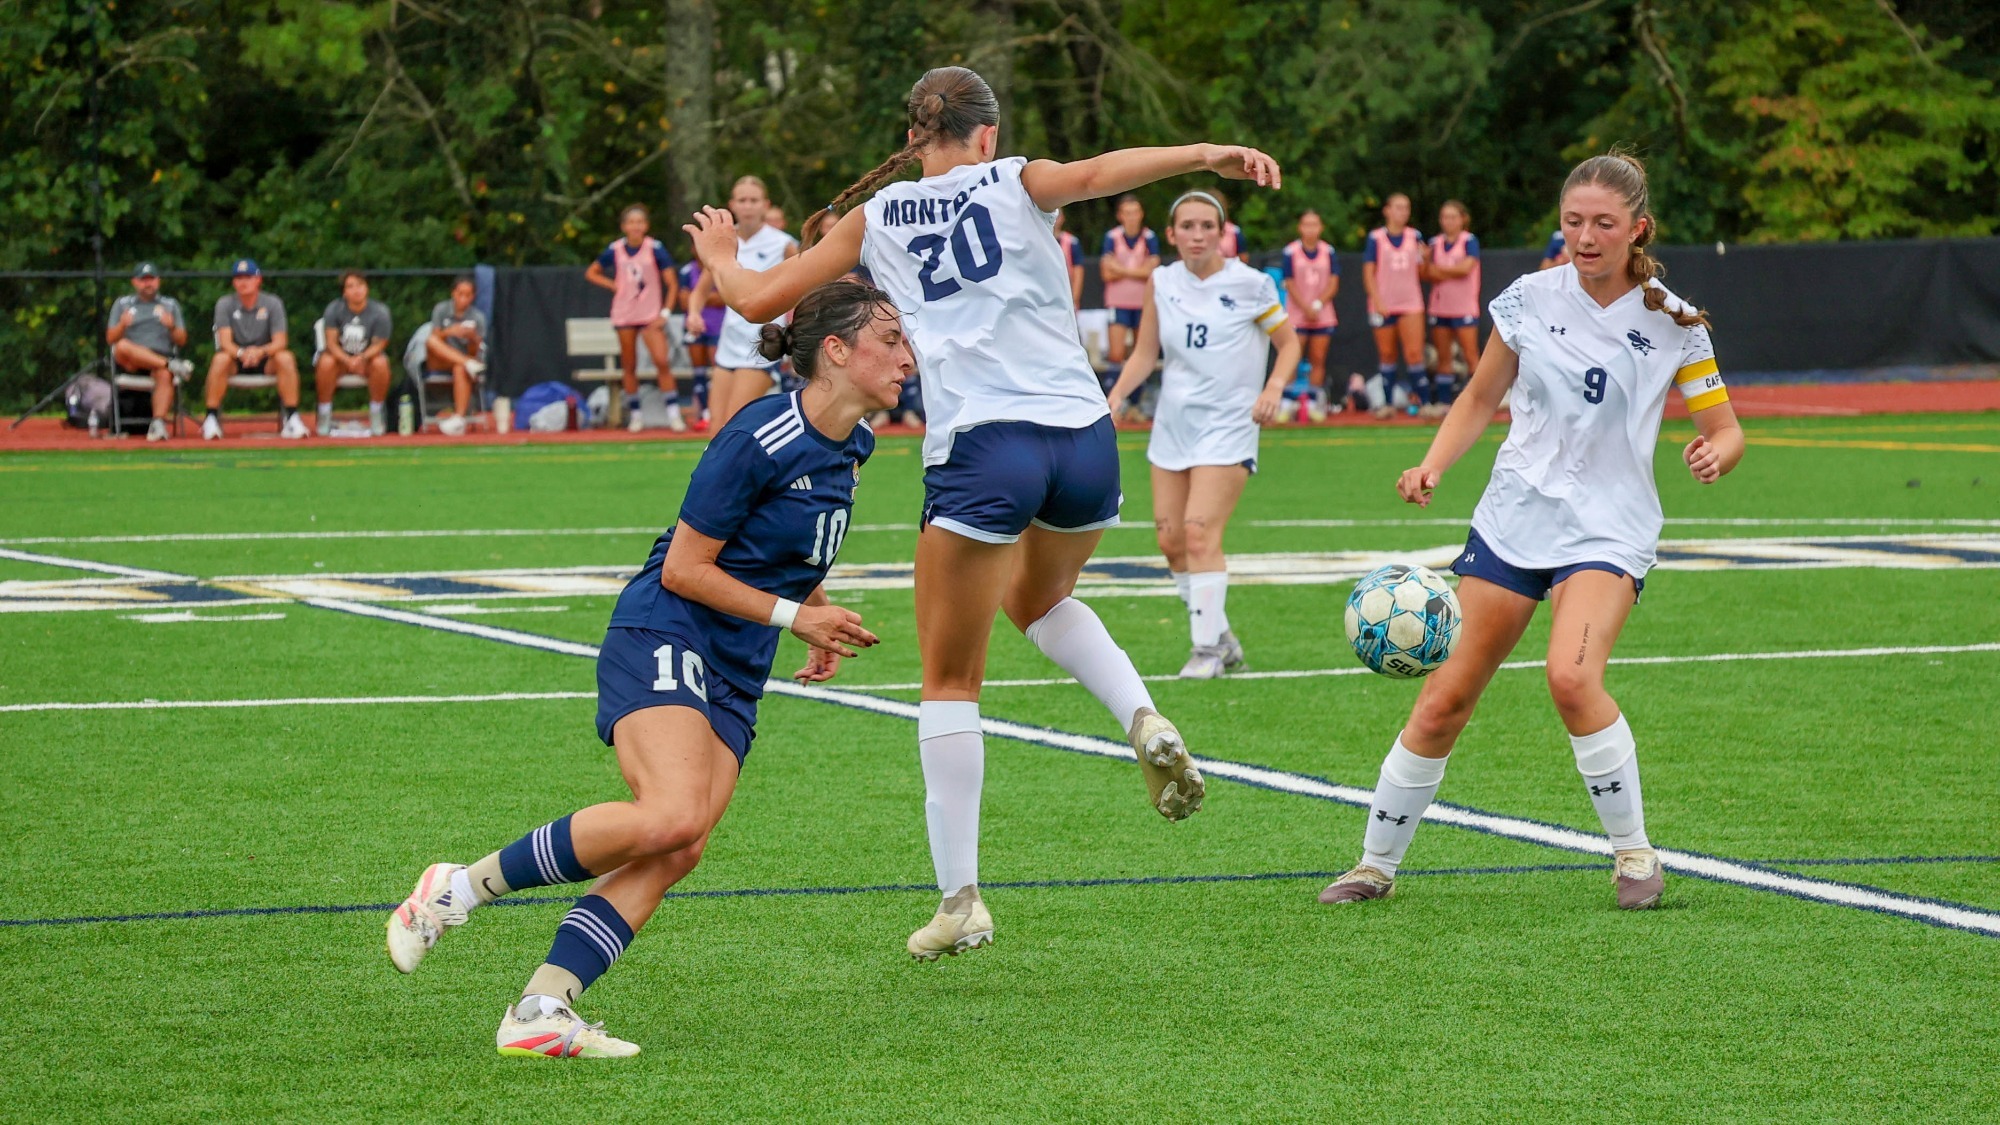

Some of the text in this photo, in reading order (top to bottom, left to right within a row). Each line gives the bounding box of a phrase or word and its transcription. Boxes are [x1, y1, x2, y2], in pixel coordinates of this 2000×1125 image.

[907, 202, 1003, 302] 20
[1186, 322, 1208, 348] 13
[1584, 367, 1607, 404] 9
[803, 508, 848, 566] 10
[653, 644, 707, 703] 10
